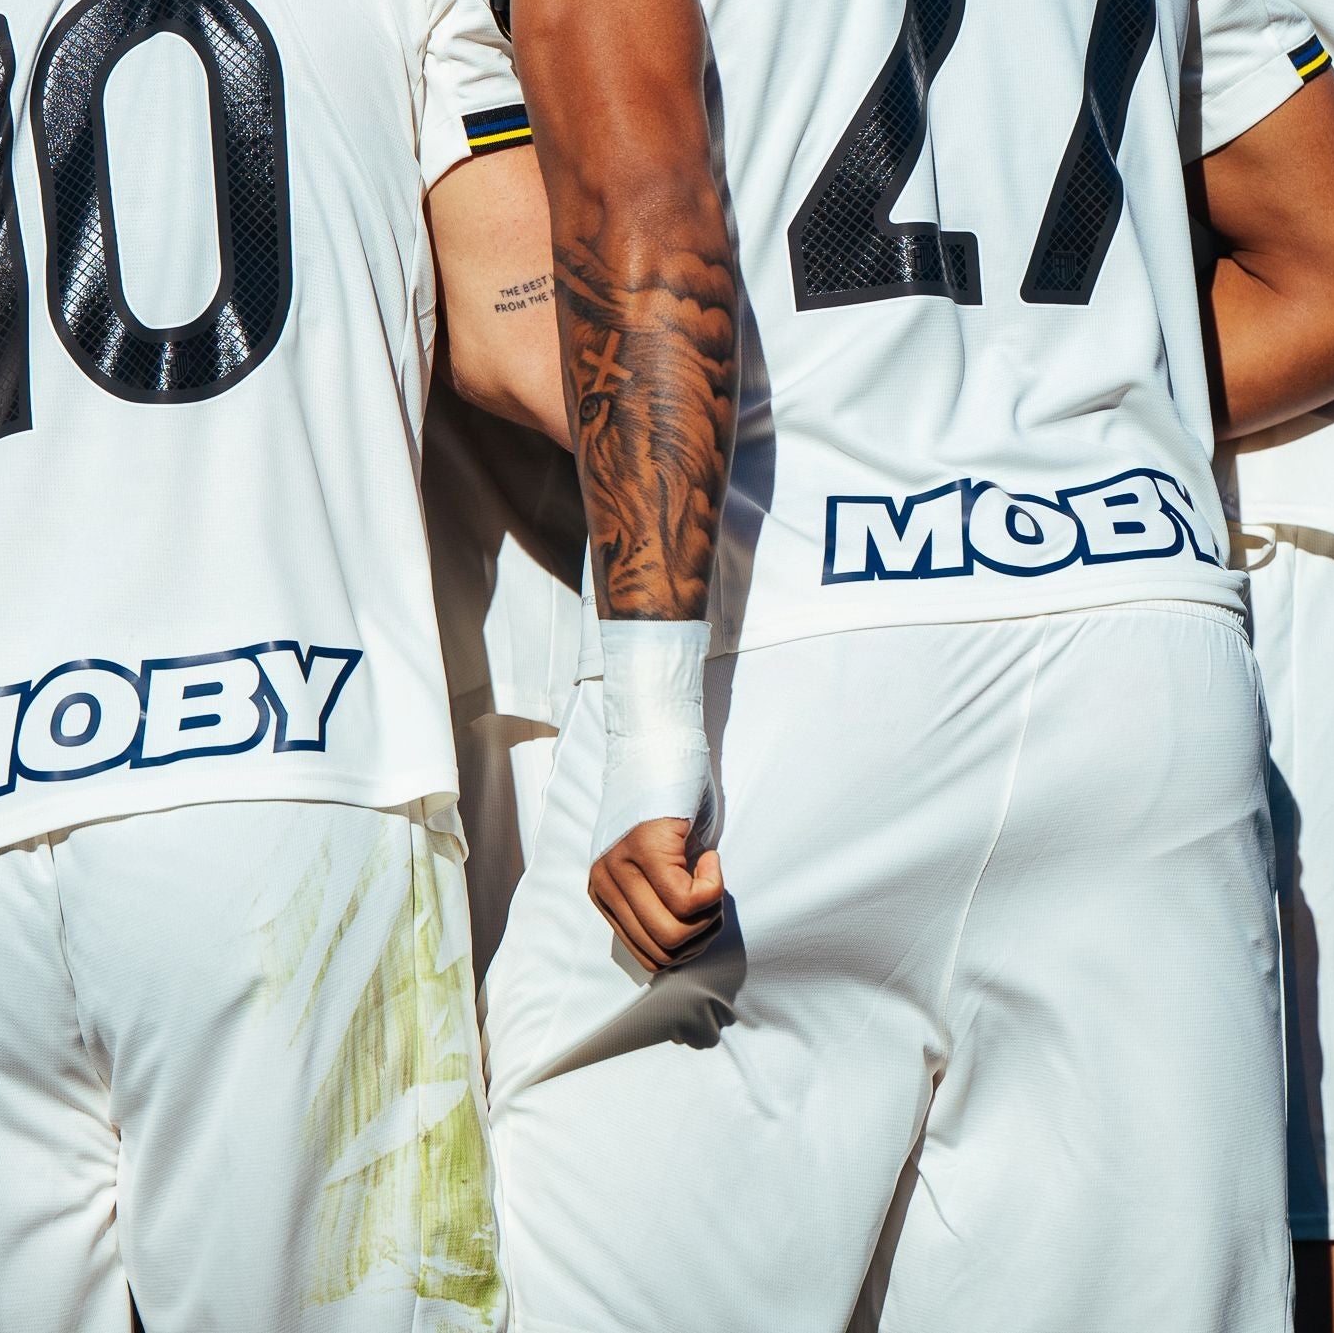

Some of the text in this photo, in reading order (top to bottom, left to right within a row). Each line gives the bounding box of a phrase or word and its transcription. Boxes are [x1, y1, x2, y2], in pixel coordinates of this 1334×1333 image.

[499, 285, 521, 298] THE
[522, 275, 548, 293] BEST
[494, 300, 527, 314] FROM
[528, 292, 549, 306] THE
